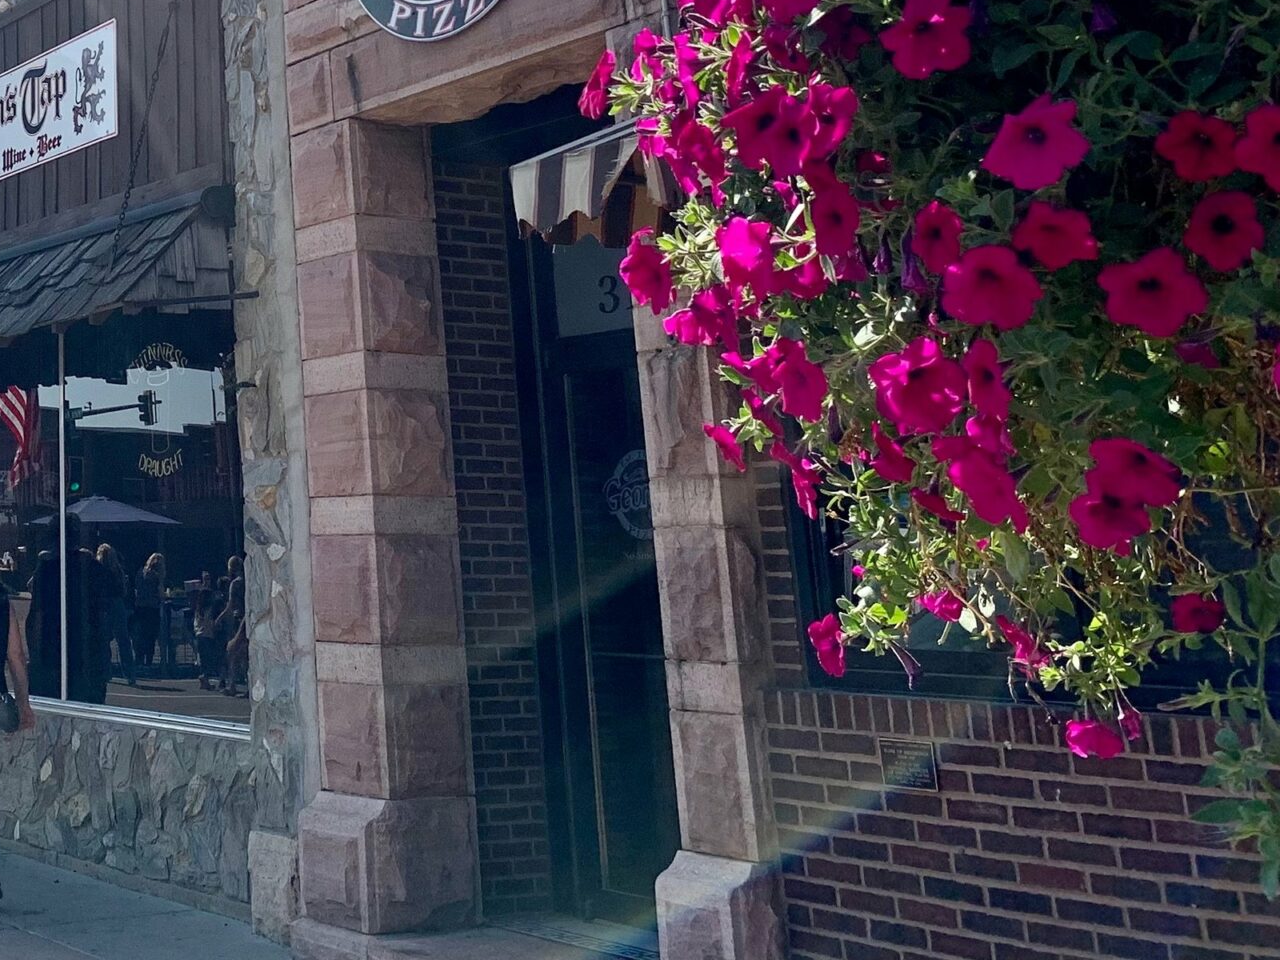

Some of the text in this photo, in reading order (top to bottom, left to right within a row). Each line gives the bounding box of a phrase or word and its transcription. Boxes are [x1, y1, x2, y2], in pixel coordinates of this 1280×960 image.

[21, 59, 67, 135] Tap
[2, 147, 27, 172] Wine
[36, 133, 62, 161] Beer
[138, 448, 184, 478] DRAUGHT
